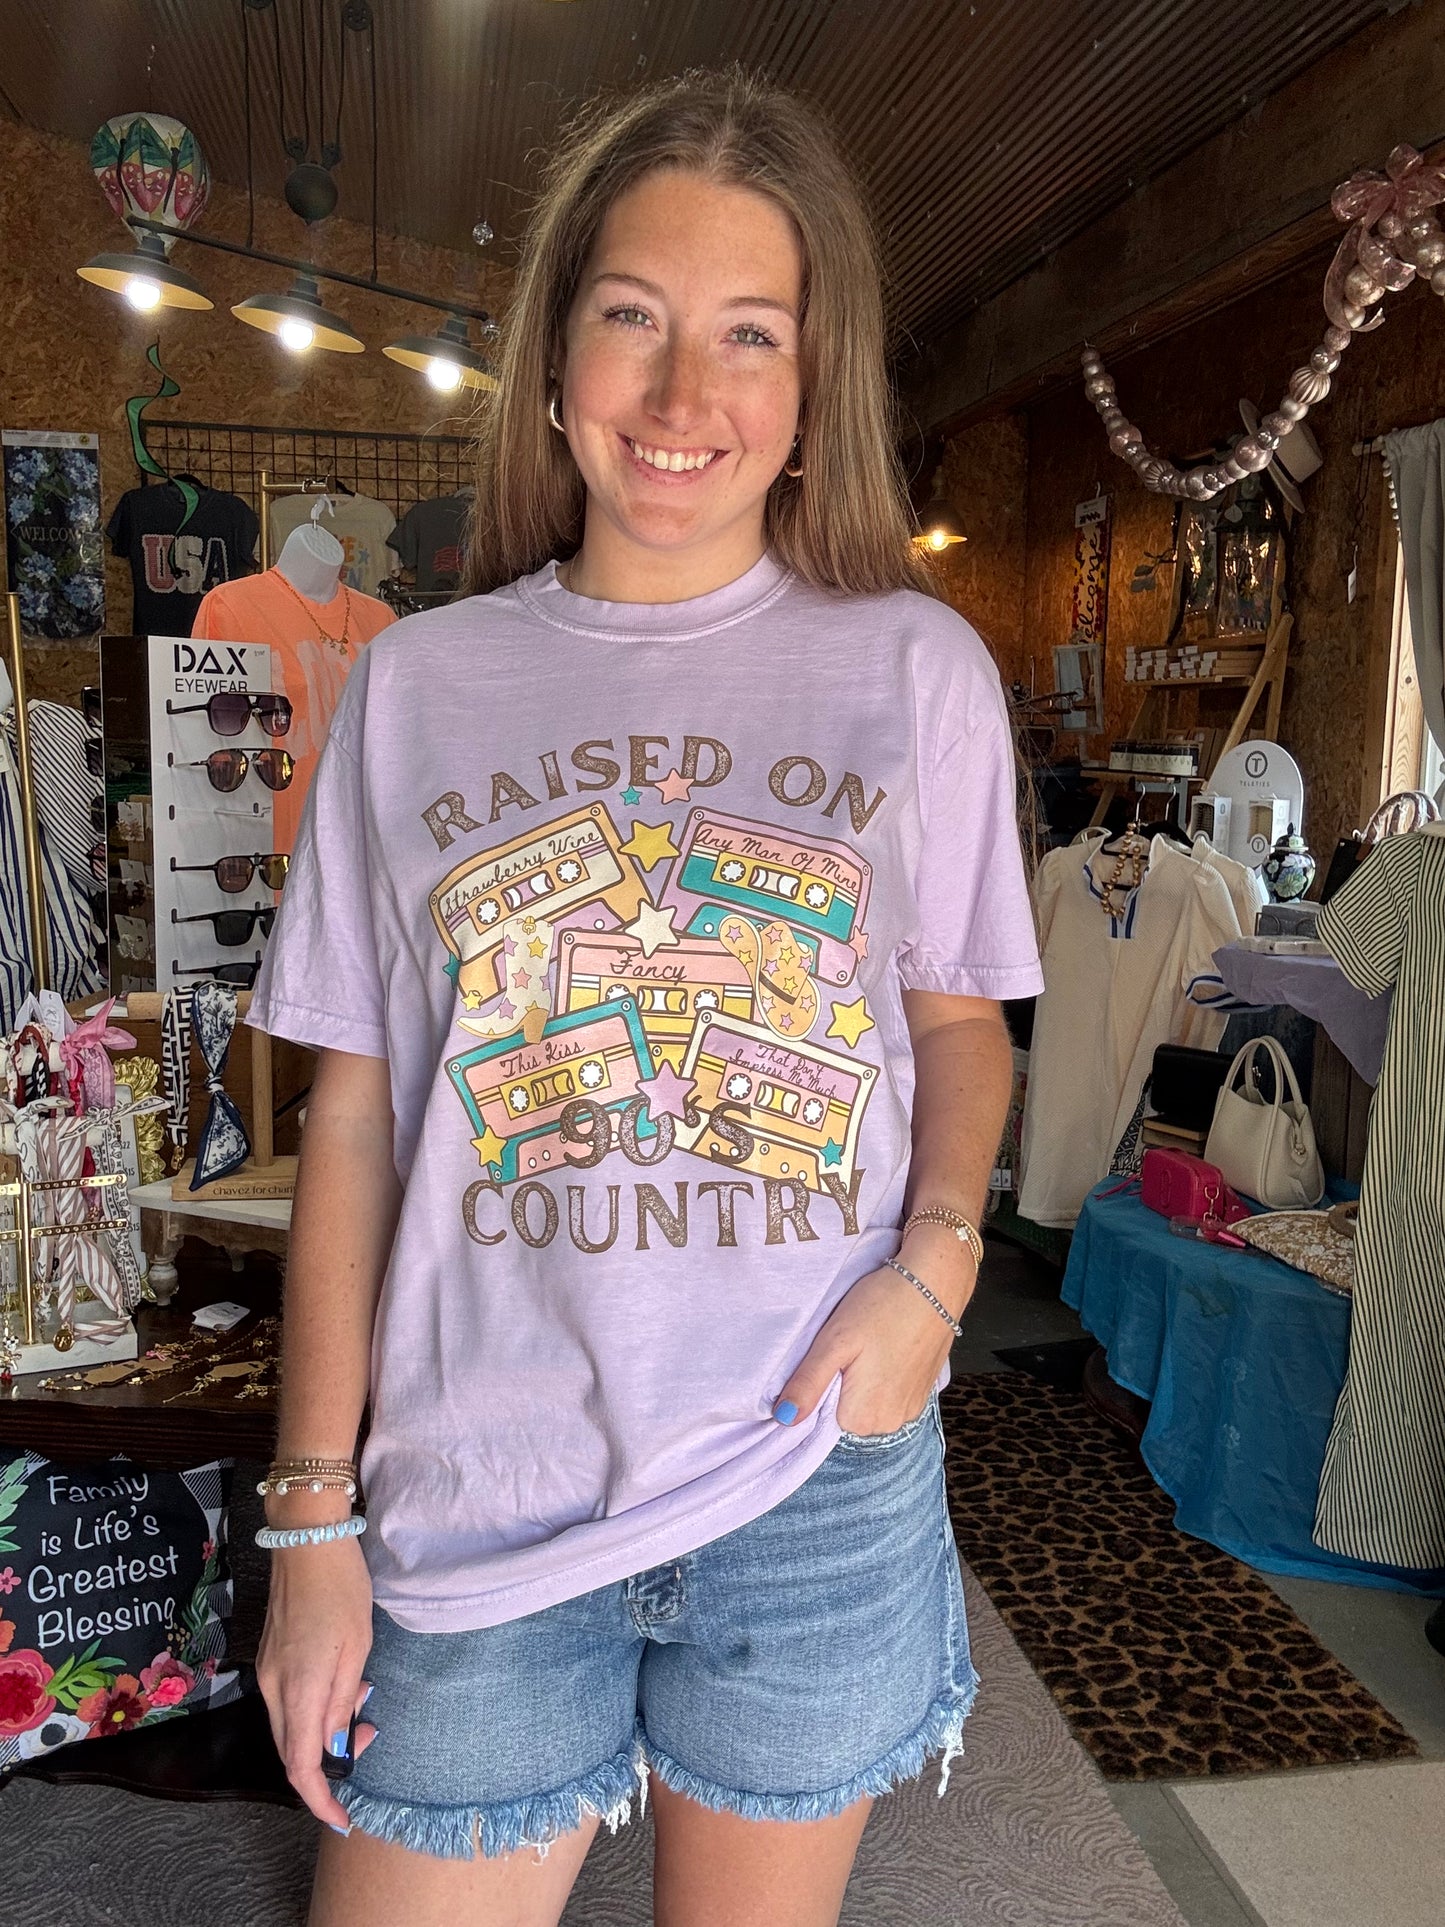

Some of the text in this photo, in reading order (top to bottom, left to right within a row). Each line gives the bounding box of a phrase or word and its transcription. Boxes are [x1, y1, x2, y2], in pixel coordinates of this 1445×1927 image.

[19, 526, 81, 541] WELCOM
[142, 533, 229, 594] USA
[1078, 531, 1100, 644] elcome
[174, 644, 249, 676] DAX
[175, 678, 248, 693] EYEWEAR
[421, 735, 887, 852] RAISED ON
[445, 832, 599, 920] Strawberry Wine
[695, 828, 860, 893] Any Man Of Mine
[610, 948, 687, 986] Fancy
[500, 1041, 586, 1078] This Kiss
[729, 1048, 784, 1080] Impress
[808, 1075, 838, 1098] Much
[755, 1044, 790, 1067] That
[213, 1185, 251, 1195] chavez
[253, 1185, 266, 1195] for
[462, 1168, 867, 1253] COUNTRY
[47, 1473, 149, 1505] Family
[41, 1505, 160, 1556] is Life's
[27, 1545, 179, 1603] Greatest
[38, 1597, 175, 1649] Blessing
